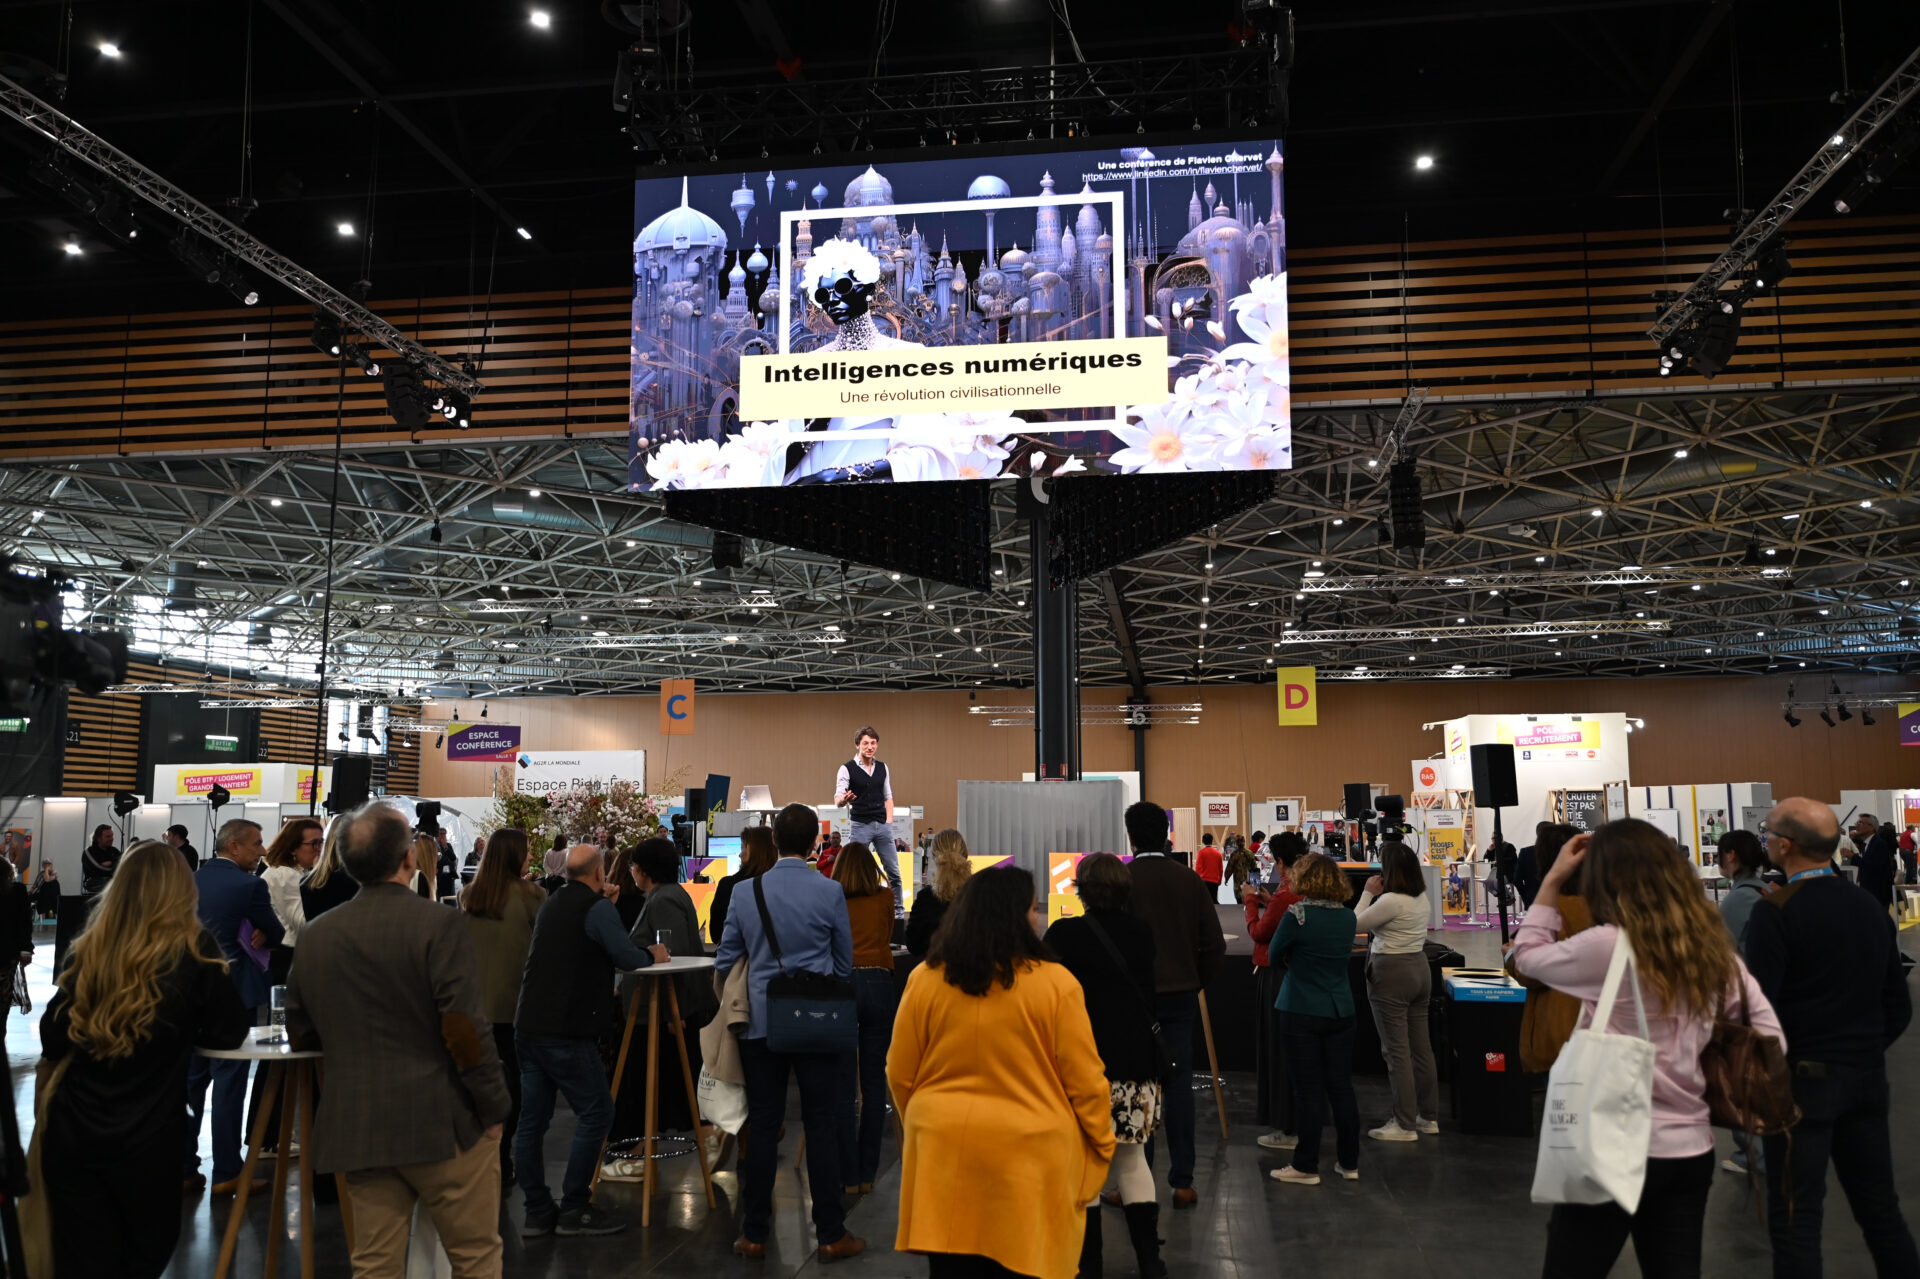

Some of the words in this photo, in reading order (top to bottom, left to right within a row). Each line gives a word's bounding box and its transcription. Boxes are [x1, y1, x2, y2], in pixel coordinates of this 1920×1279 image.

[1098, 161, 1116, 170] Une
[1119, 158, 1171, 169] conférence
[1174, 157, 1186, 166] de
[1188, 155, 1222, 165] Flavien
[1225, 153, 1263, 163] Chervet
[765, 361, 954, 384] Intelligences
[965, 352, 1142, 374] numériques
[840, 391, 869, 403] Une
[874, 388, 945, 402] révolution
[950, 383, 1062, 399] civilisationnelle
[1284, 683, 1309, 710] D
[667, 694, 688, 720] C
[468, 731, 500, 740] ESPACE
[1536, 726, 1556, 735] PÔL
[456, 740, 512, 750] CONFÉRENCE
[1518, 734, 1578, 745] RECRUTEMENT
[185, 776, 201, 785] PÔLE
[218, 773, 251, 782] LOGEMENT
[189, 783, 214, 792] GRANDS
[221, 781, 248, 789] HANTIERS
[517, 778, 567, 794] Espace
[1580, 801, 1595, 810] PAS
